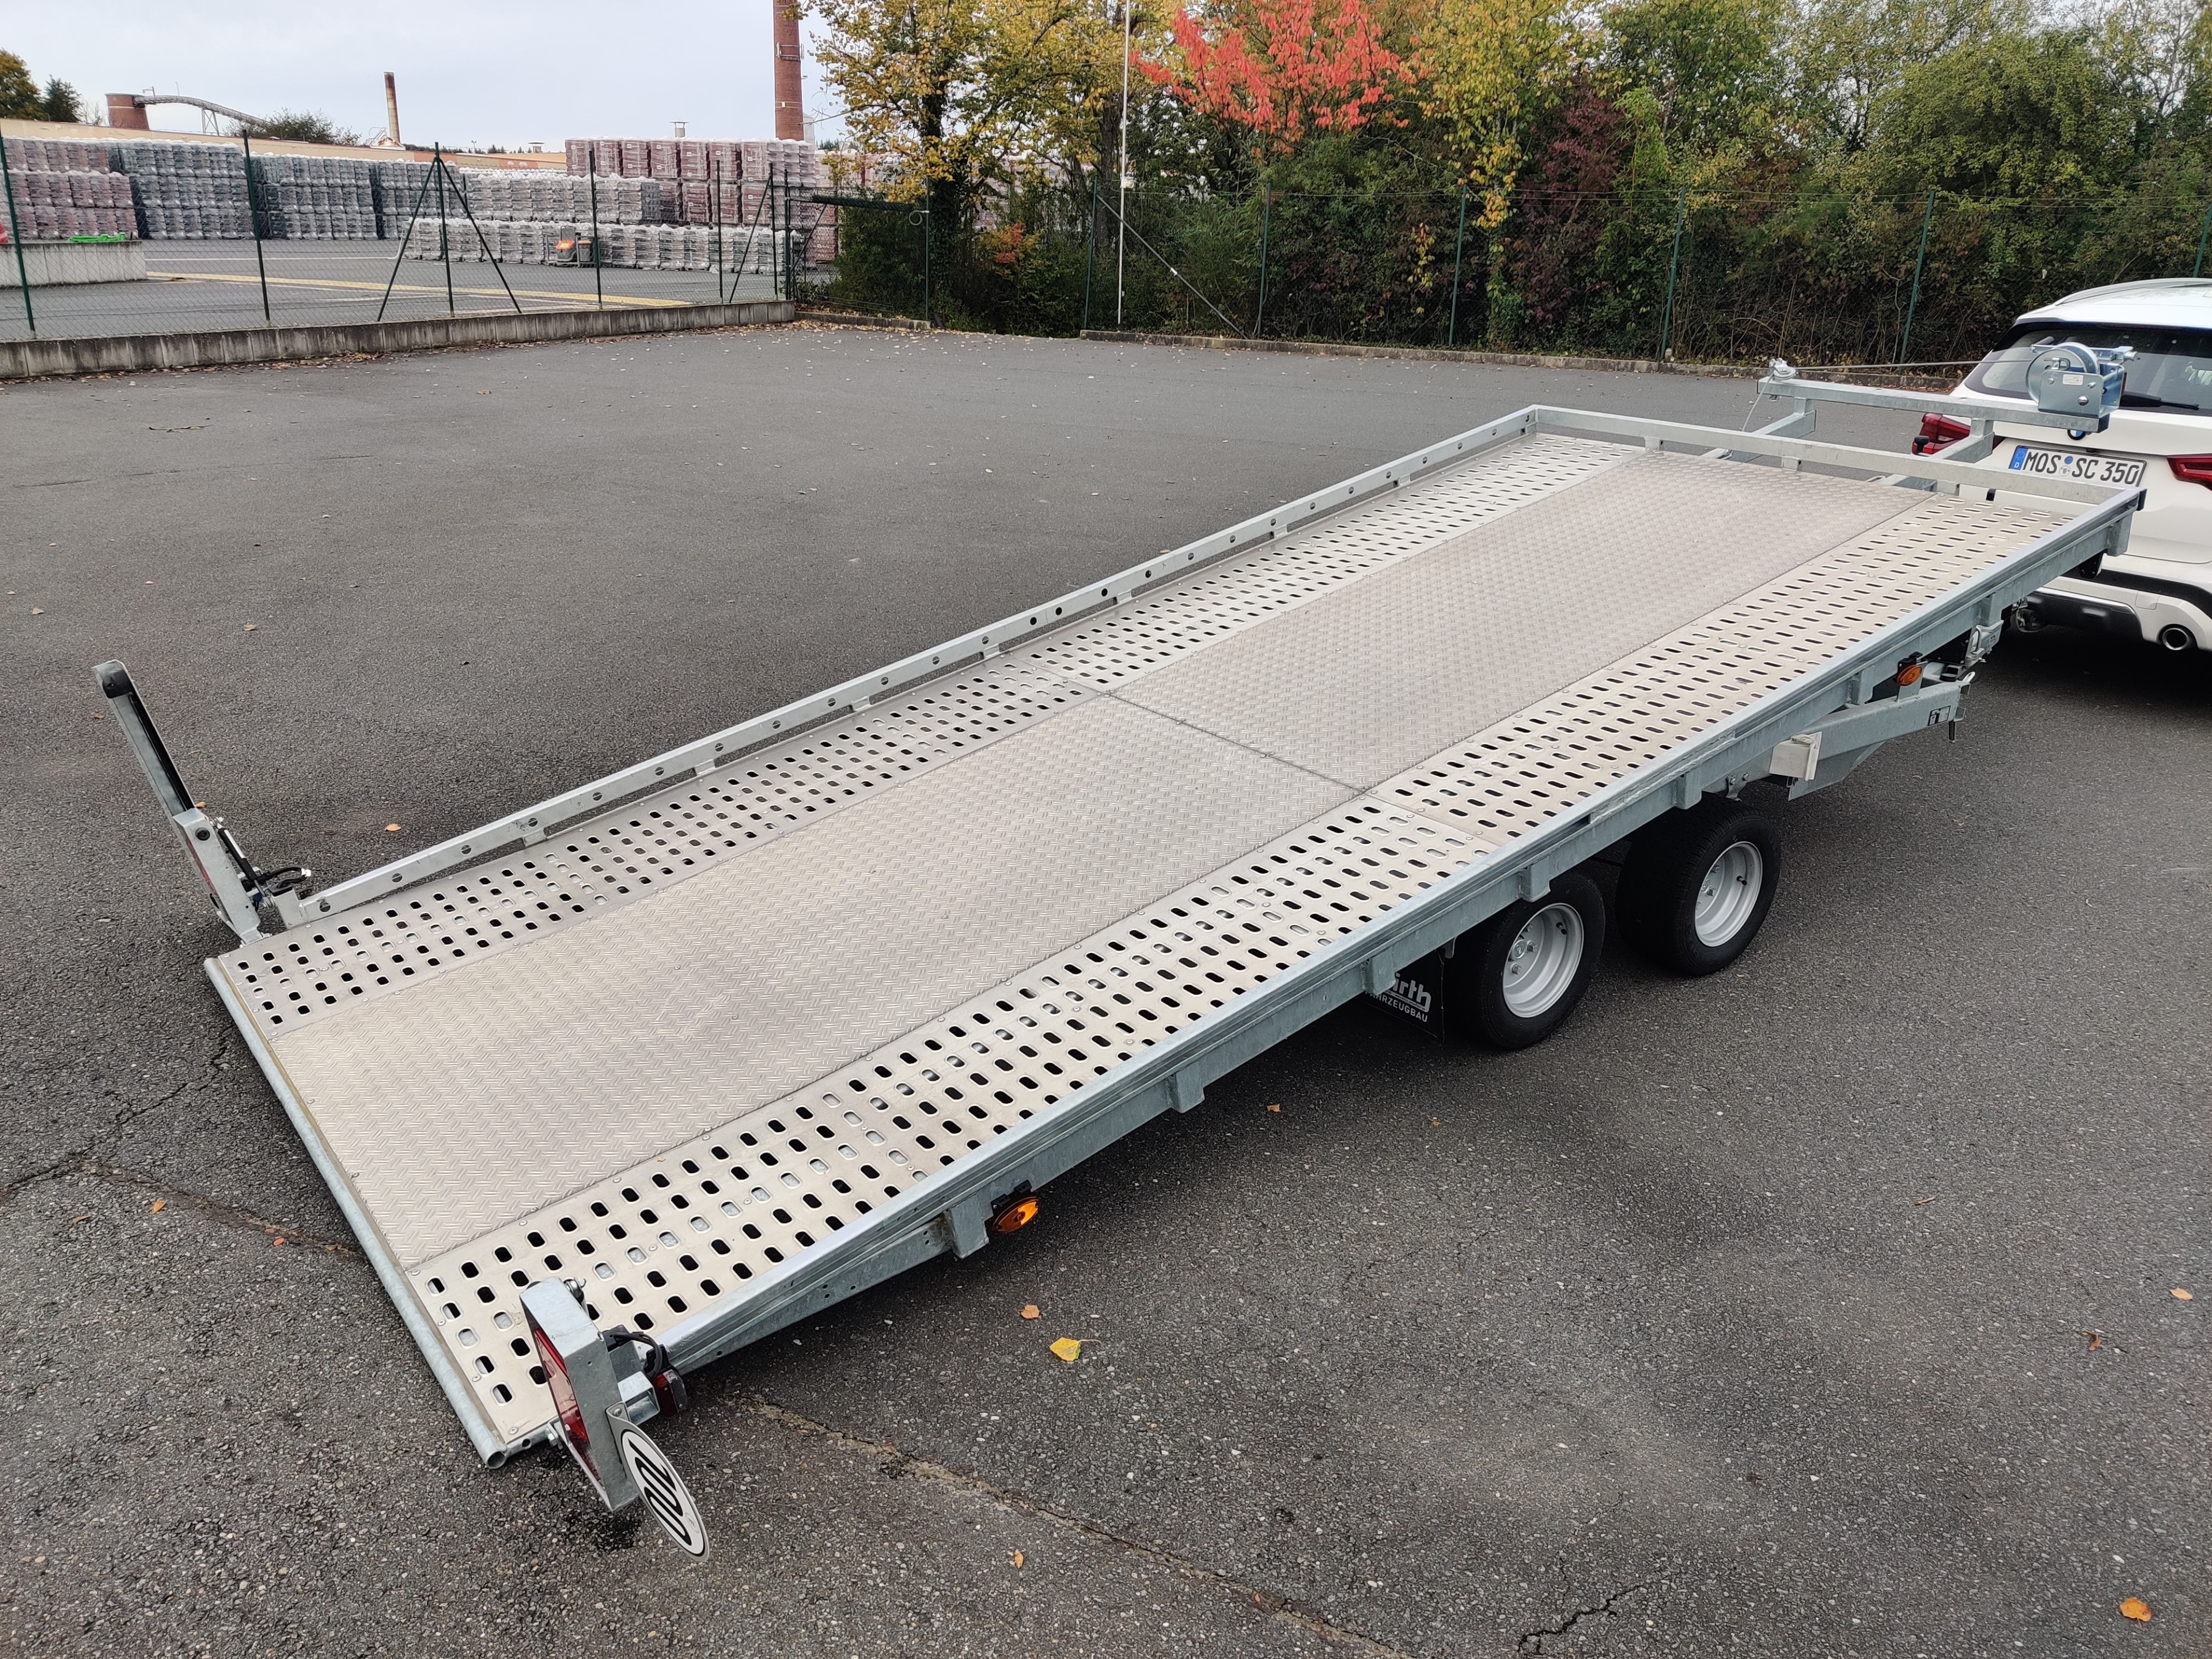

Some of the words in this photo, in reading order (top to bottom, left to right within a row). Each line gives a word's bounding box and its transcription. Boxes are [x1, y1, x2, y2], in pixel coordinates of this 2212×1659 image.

[2022, 451, 2062, 474] MOS
[2072, 458, 2099, 479] SC
[2100, 461, 2140, 484] 350
[1365, 991, 1427, 1022] HRZEUGBAU
[1393, 972, 1431, 1013] irth
